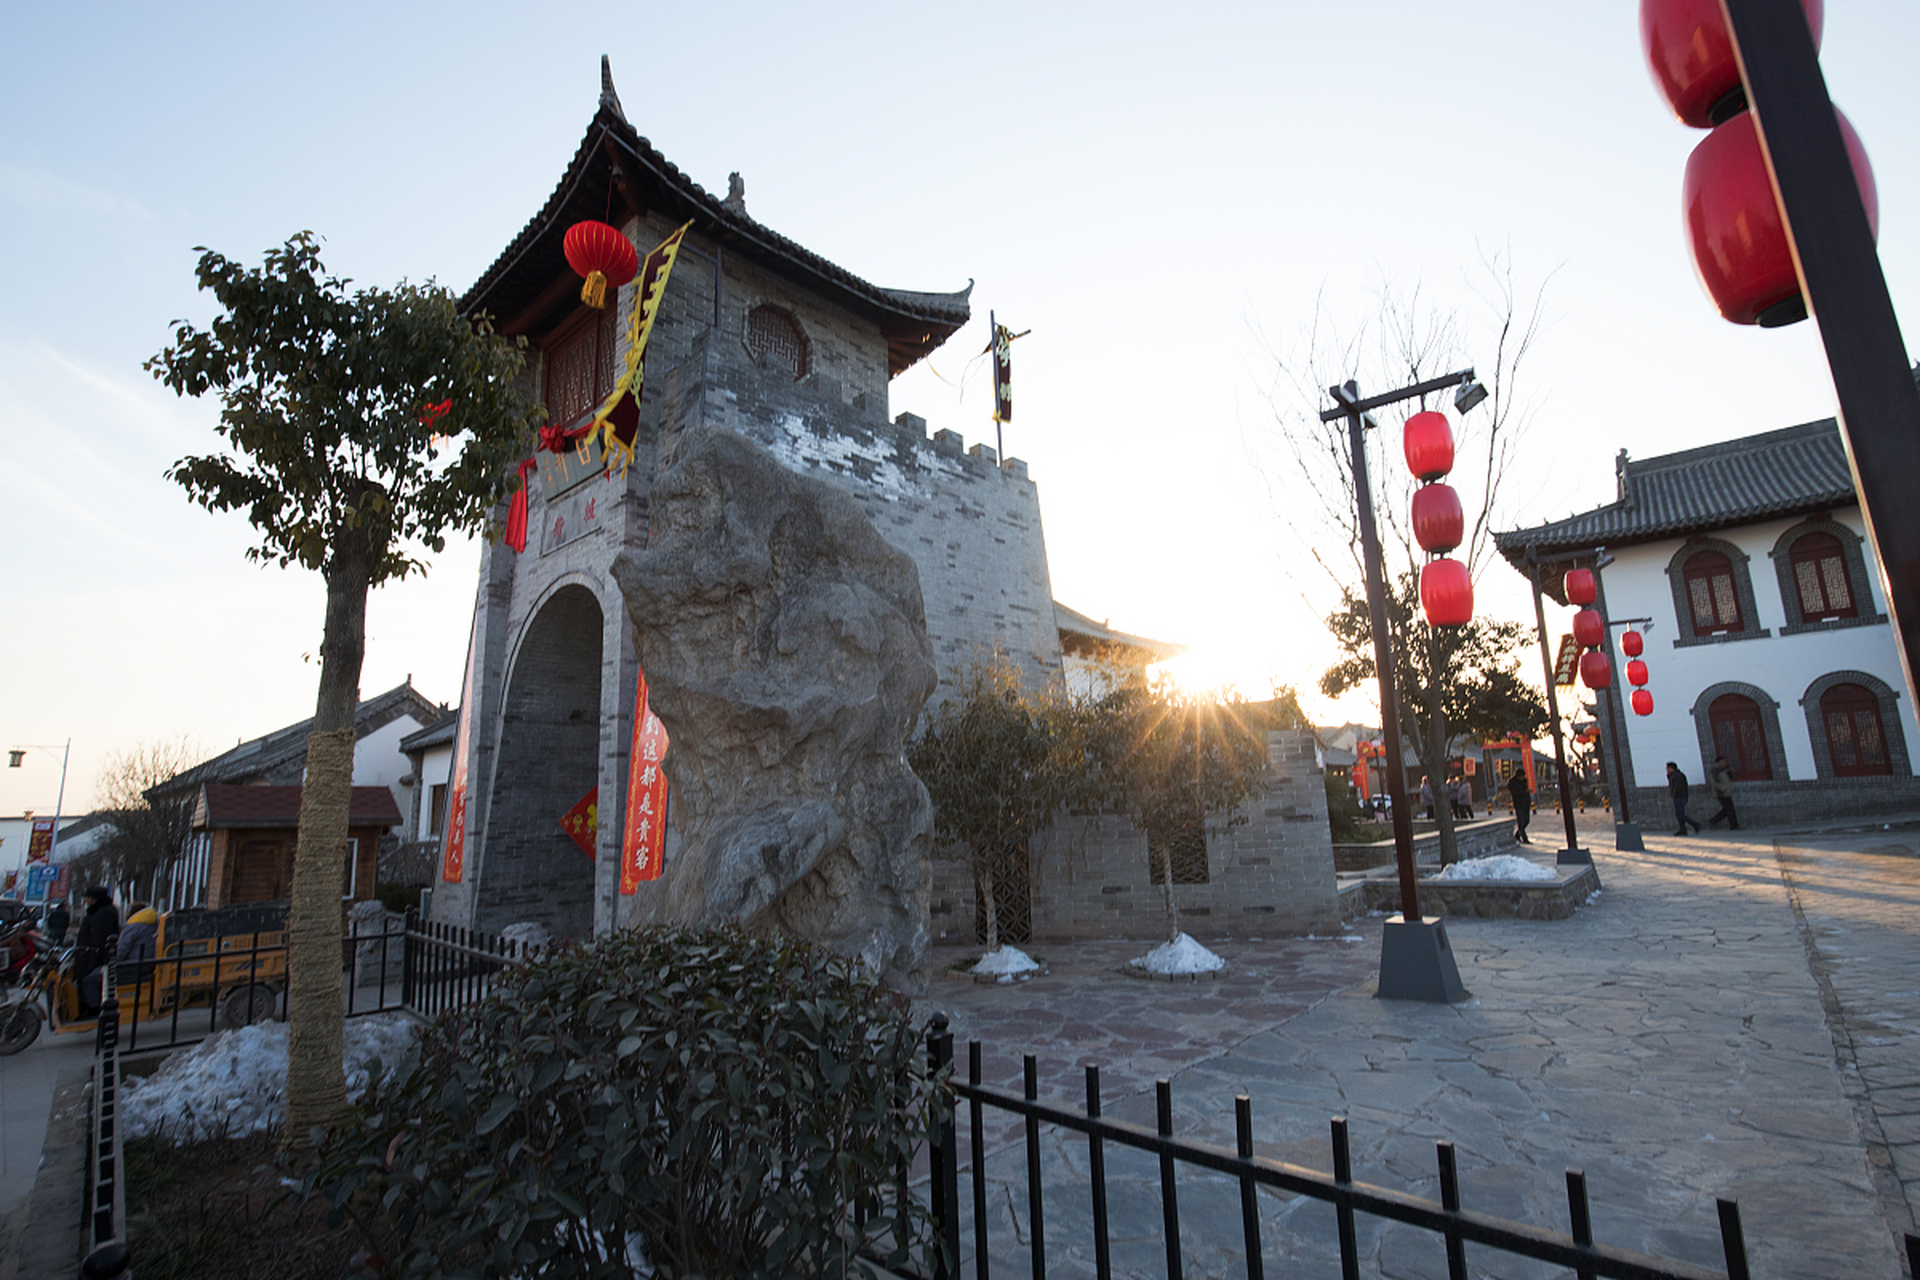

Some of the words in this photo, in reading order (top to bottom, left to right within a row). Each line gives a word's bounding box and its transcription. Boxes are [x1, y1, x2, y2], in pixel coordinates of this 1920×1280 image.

[635, 715, 660, 870] 到这都是贵客
